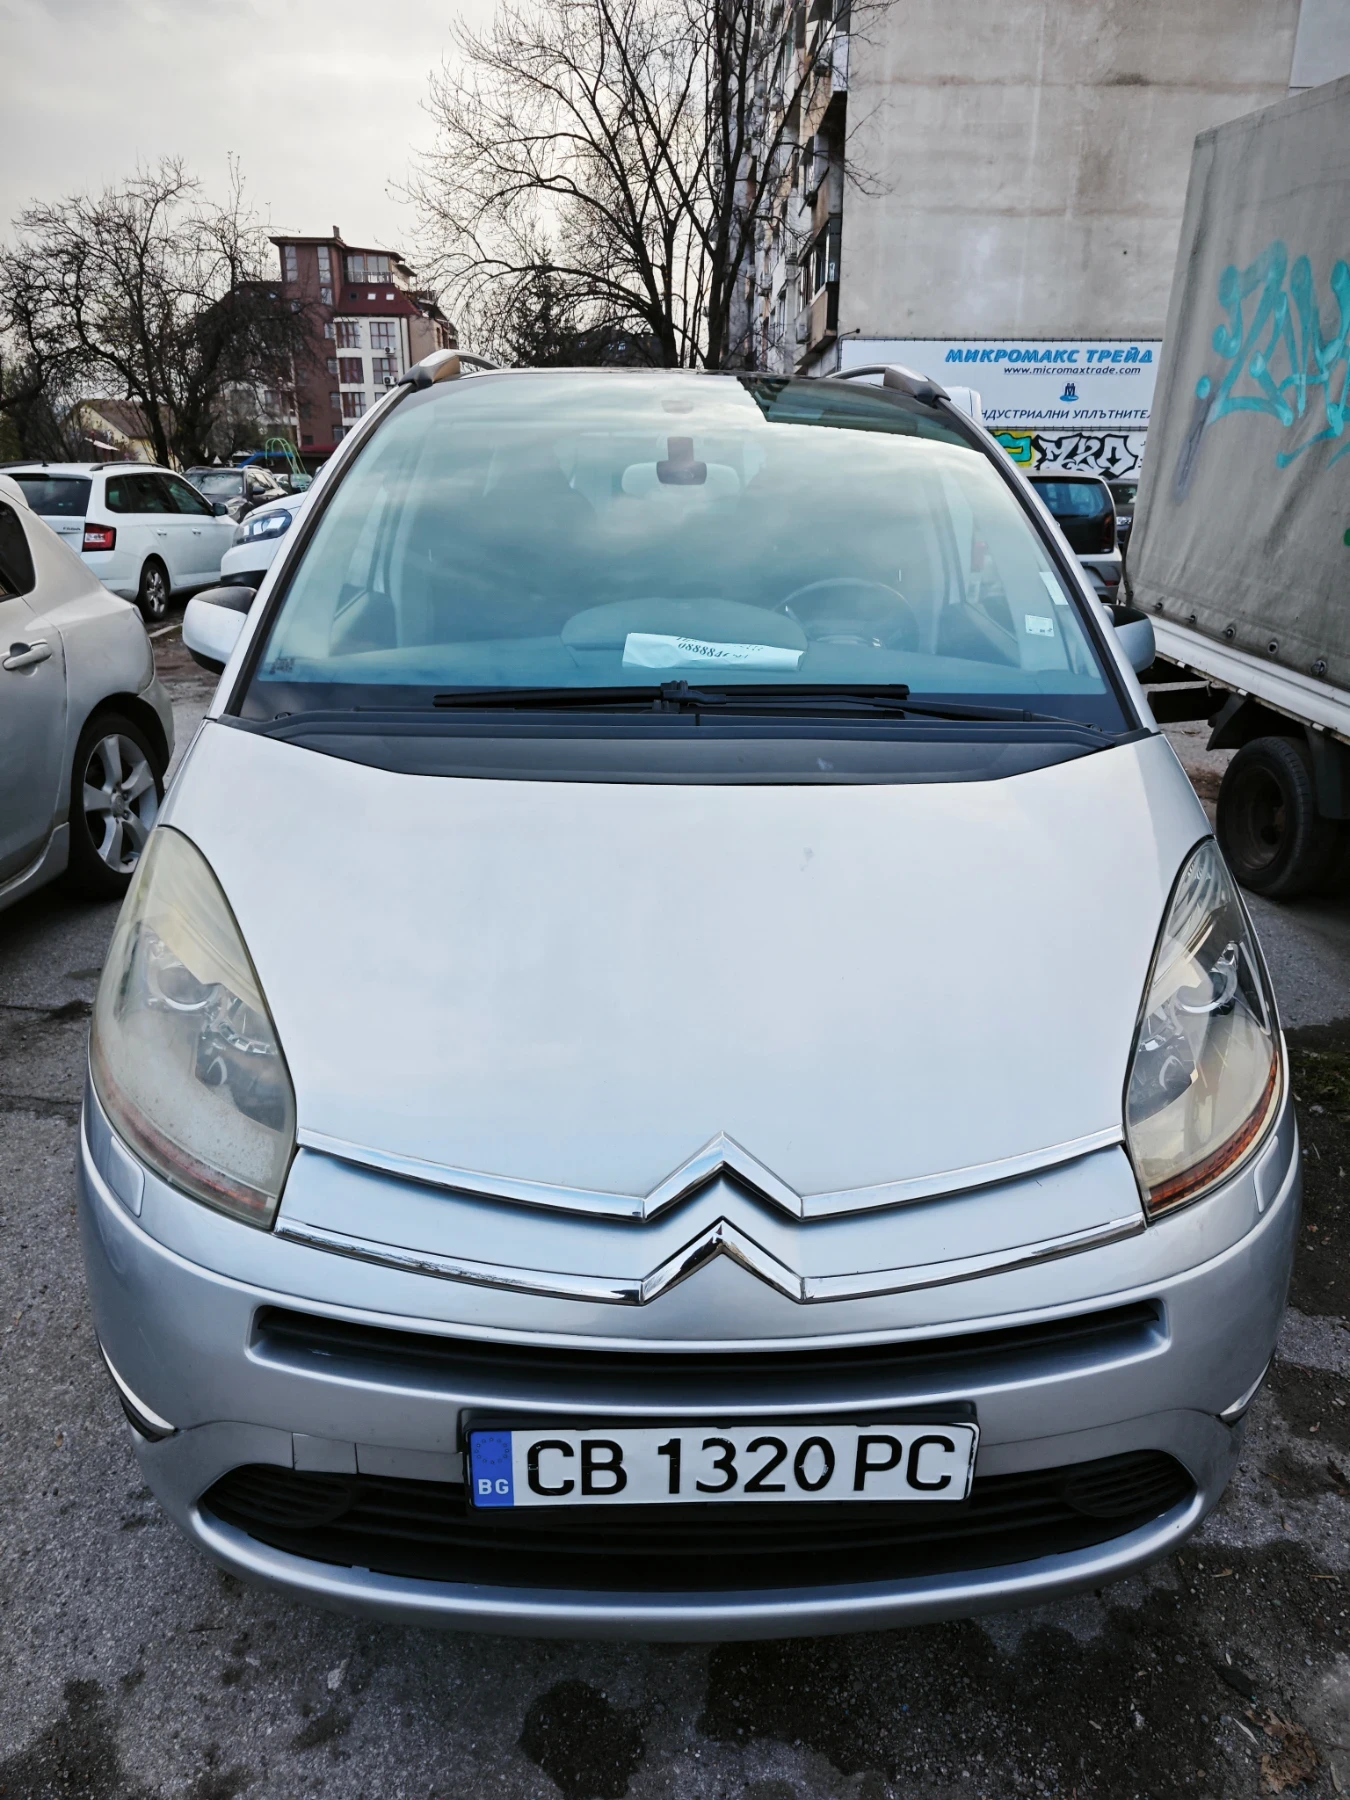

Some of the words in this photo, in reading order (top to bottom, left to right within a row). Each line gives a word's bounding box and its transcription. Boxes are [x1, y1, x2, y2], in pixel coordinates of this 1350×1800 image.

[945, 349, 1080, 363] МИКРОМАКС
[1086, 347, 1153, 363] ТРЕЙД
[1003, 366, 1141, 375] www.micromaxtrade.com
[981, 409, 1069, 421] НДУСТРИАЛНИ
[1073, 409, 1151, 420] УПЛЪТНИТЕ
[527, 1439, 627, 1496] CB
[657, 1436, 835, 1494] 1320
[853, 1434, 955, 1492] PC
[478, 1479, 509, 1495] BG
